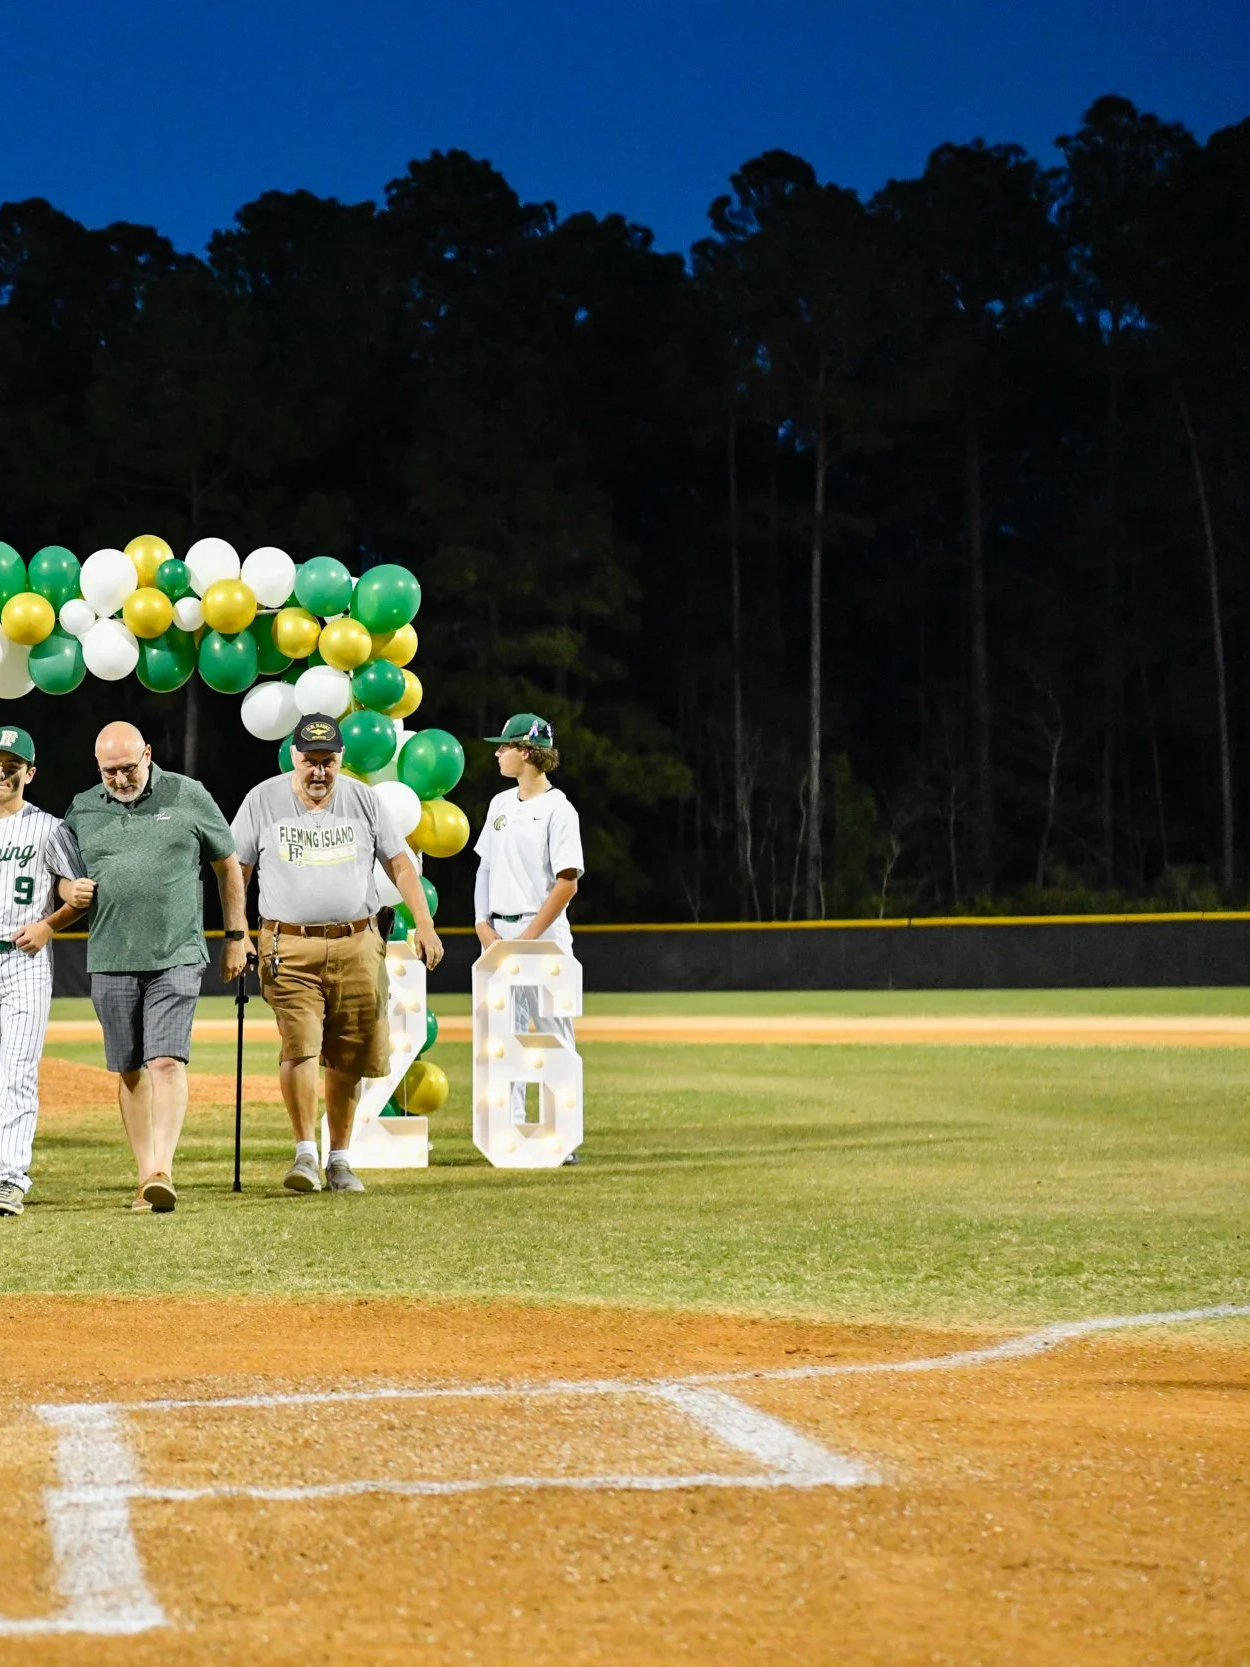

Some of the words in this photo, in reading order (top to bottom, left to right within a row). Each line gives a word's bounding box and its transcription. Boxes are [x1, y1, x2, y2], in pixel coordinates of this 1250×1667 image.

[279, 826, 319, 848] FLEMING
[321, 826, 354, 848] ISLAND
[13, 876, 35, 905] 9
